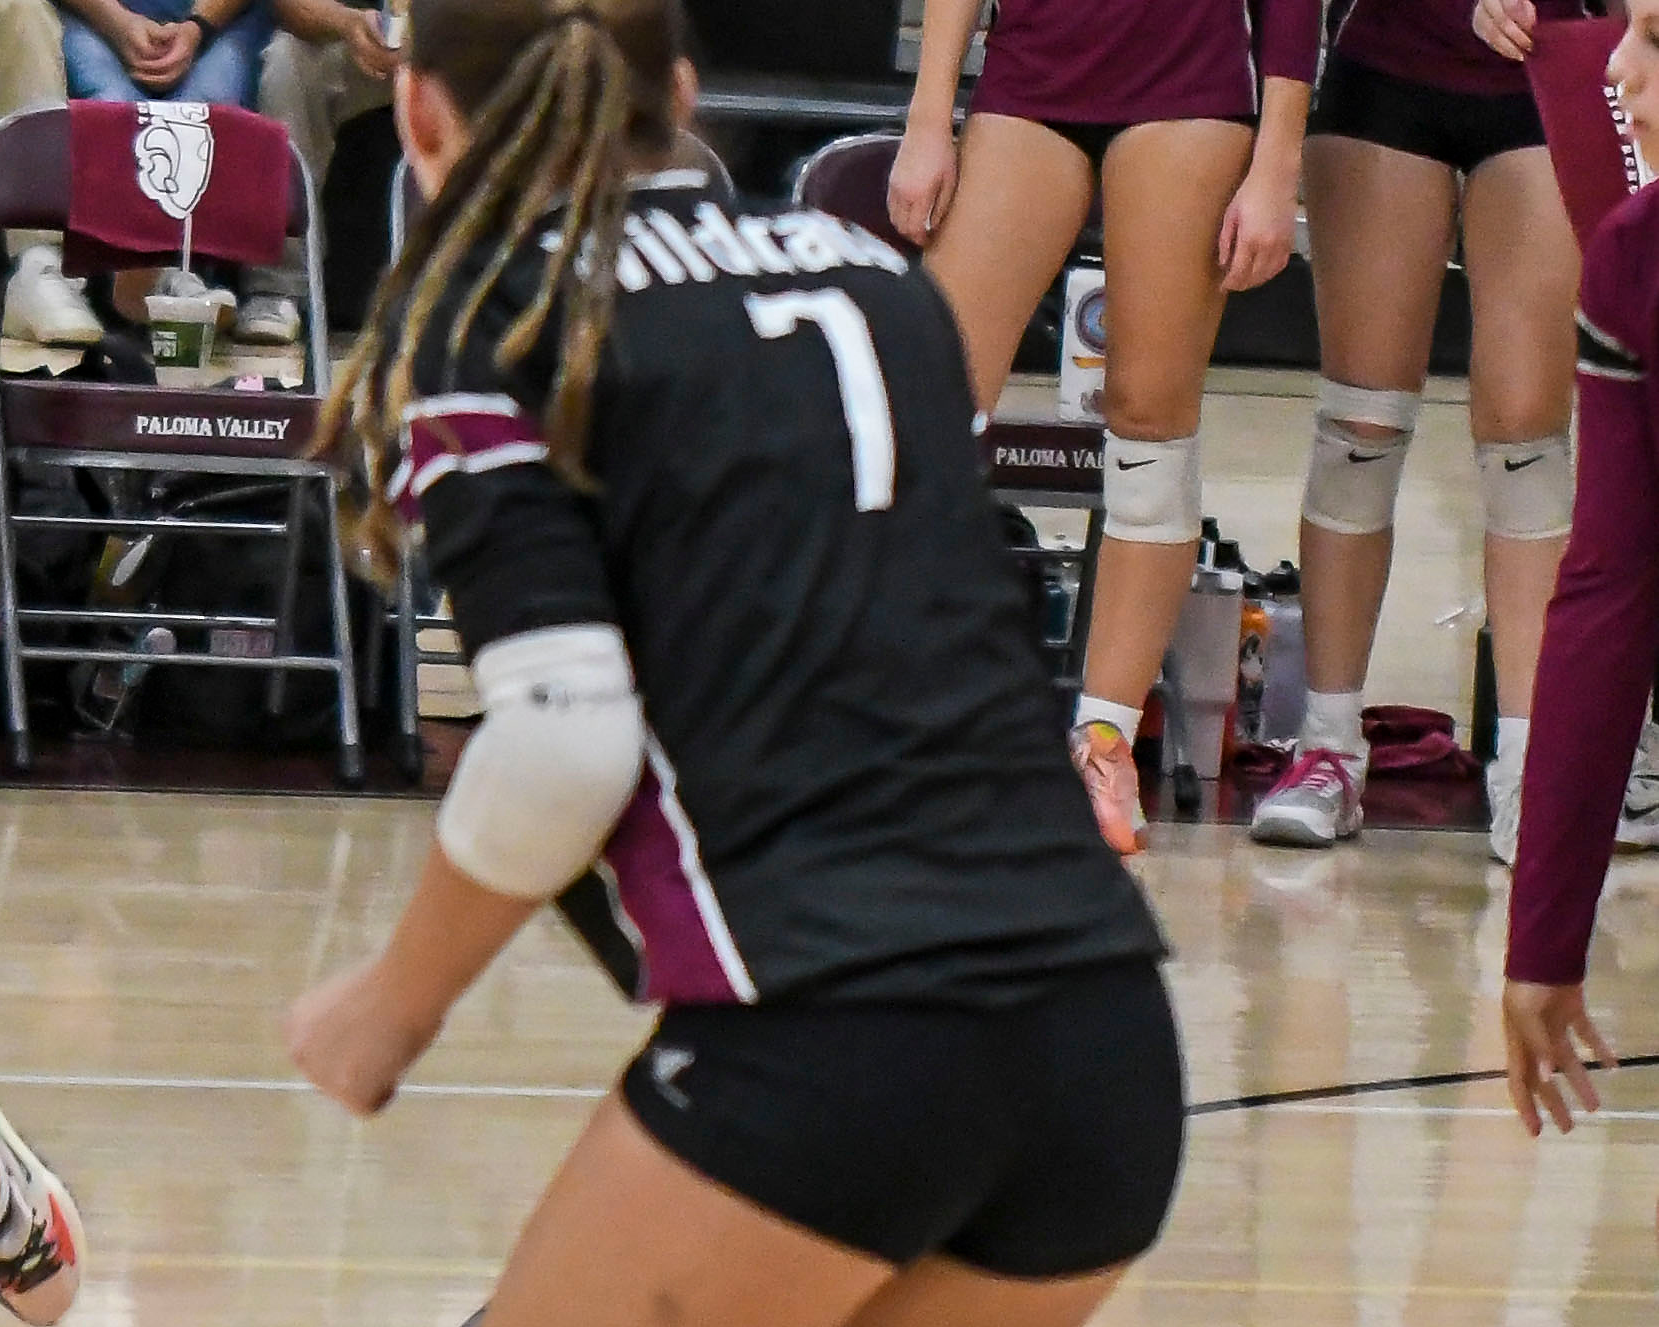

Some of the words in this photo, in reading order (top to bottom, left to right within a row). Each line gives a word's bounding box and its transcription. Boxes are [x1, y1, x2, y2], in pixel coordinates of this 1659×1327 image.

[743, 287, 896, 512] 7
[136, 415, 213, 437] PALOMA
[217, 417, 290, 440] VALLEY
[996, 447, 1068, 468] PALOMA
[1073, 449, 1103, 469] VAL
